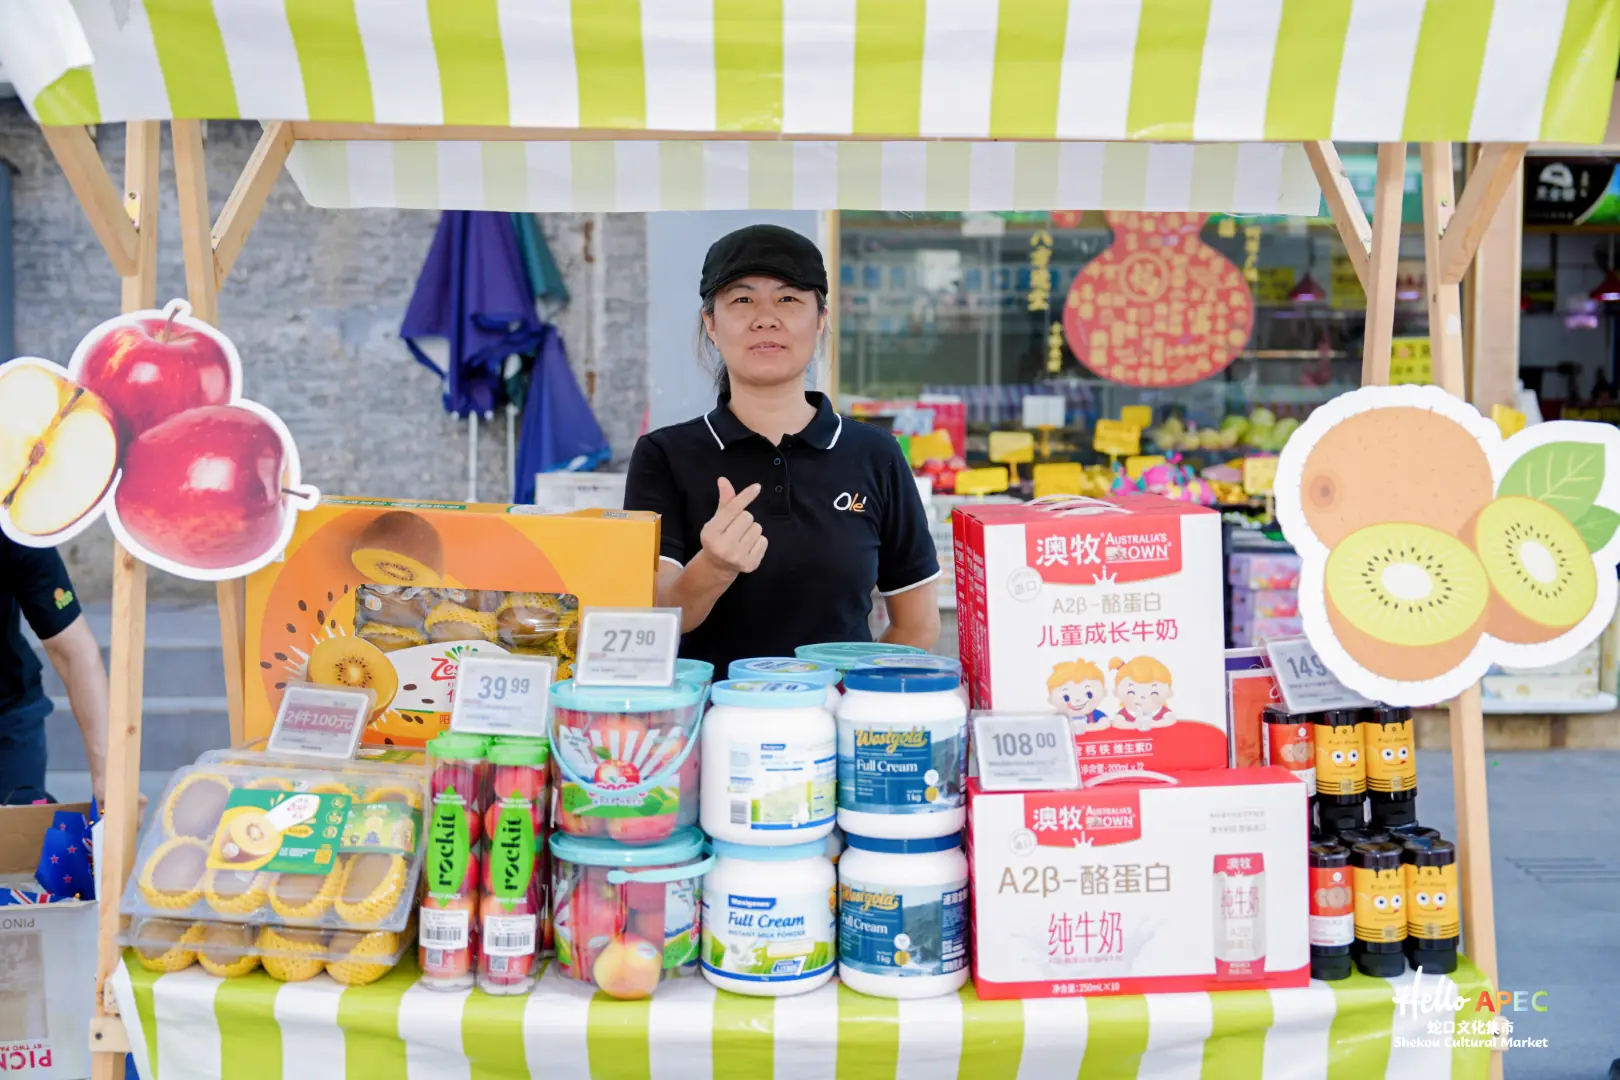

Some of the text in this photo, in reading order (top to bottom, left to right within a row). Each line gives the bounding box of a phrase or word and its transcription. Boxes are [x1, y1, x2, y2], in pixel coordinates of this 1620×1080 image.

[1036, 533, 1101, 567] 澳牧
[1105, 532, 1167, 545] AUSTRALIA'S
[1128, 546, 1168, 559] OWN
[602, 630, 655, 652] 27 90
[1037, 618, 1178, 648] 儿童成长牛奶
[478, 676, 530, 700] 39 99
[285, 710, 353, 730] 2件100元
[992, 732, 1056, 756] 108 00
[856, 759, 918, 773] Full Cream
[1032, 806, 1083, 831] 澳牧
[1103, 815, 1133, 827] OWN
[435, 813, 456, 886] rockit
[501, 816, 522, 890] rockit
[1227, 857, 1252, 870] 澳牧
[998, 862, 1171, 898] A2β-酪蛋白
[1221, 886, 1259, 914] 纯牛奶
[0, 918, 35, 930] PINO
[728, 911, 804, 928] Full Cream
[854, 918, 888, 934] Cream
[1048, 911, 1123, 956] 纯牛奶
